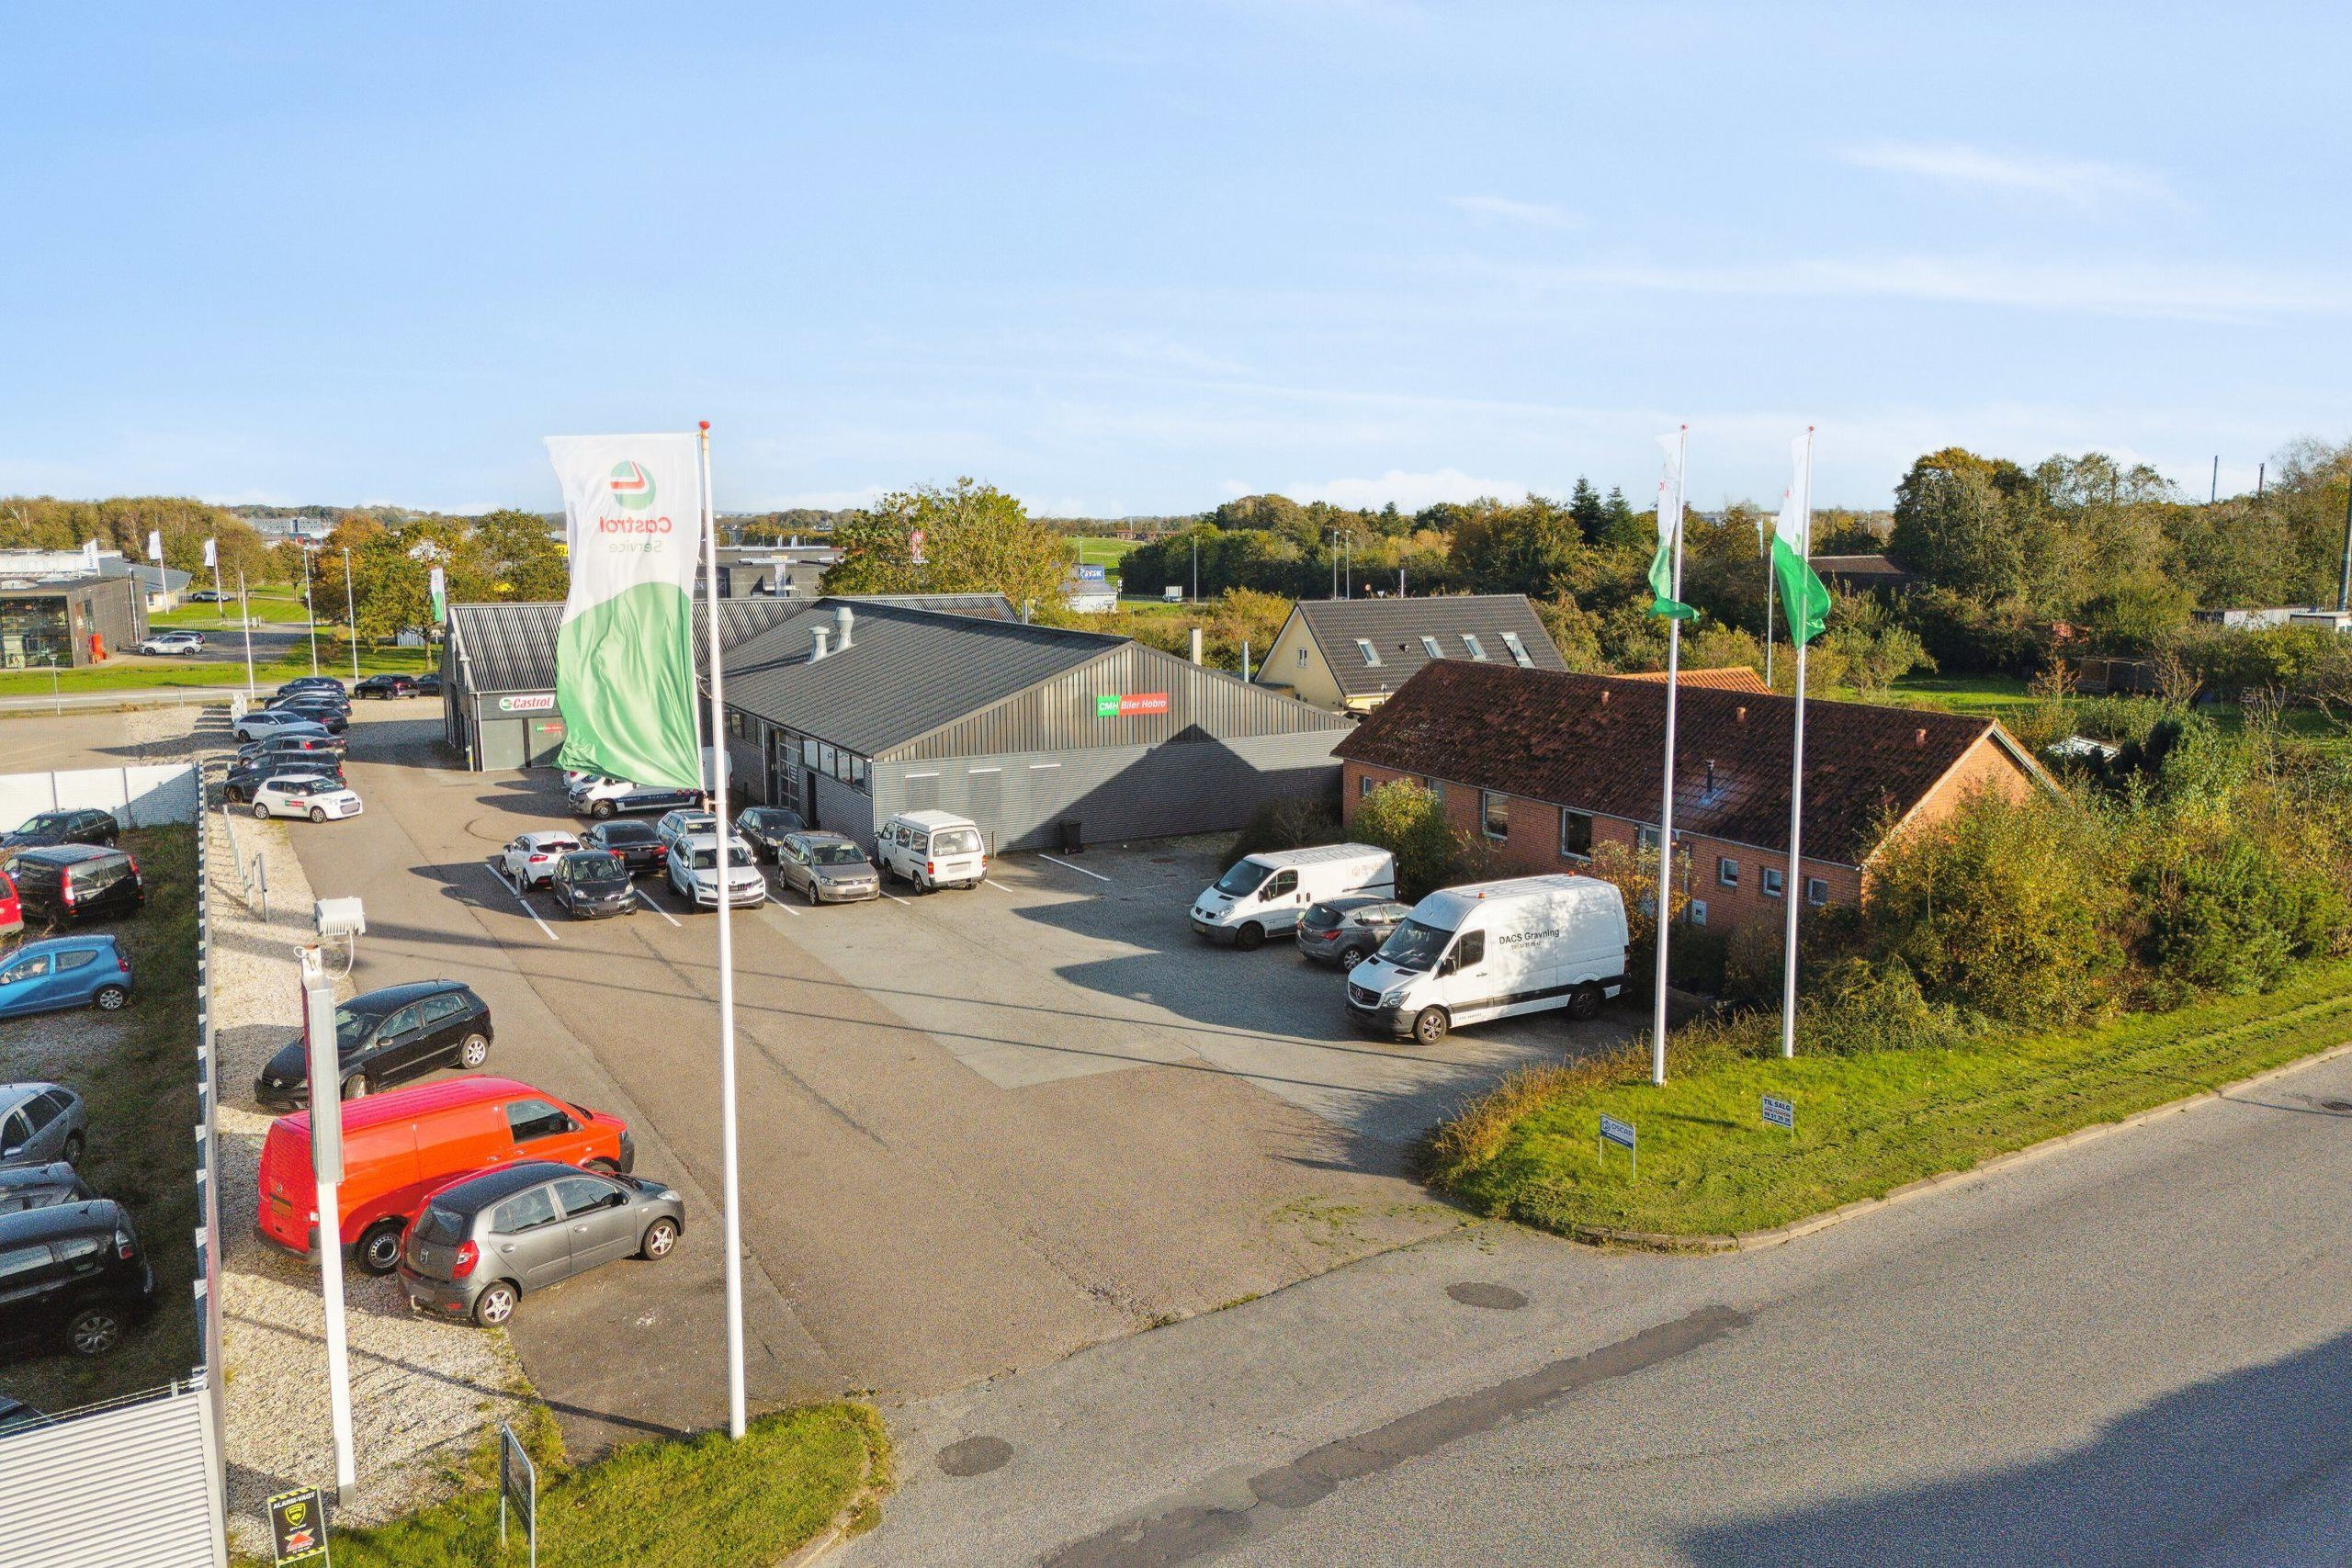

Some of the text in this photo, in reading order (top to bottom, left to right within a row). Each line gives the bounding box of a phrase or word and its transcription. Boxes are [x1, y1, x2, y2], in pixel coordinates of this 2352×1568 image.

[513, 697, 550, 708] Castrol
[1121, 701, 1139, 709] Biler
[1141, 700, 1166, 709] Hobro
[1499, 929, 1559, 944] DACS Gravning
[1611, 1123, 1633, 1137] OSCAR
